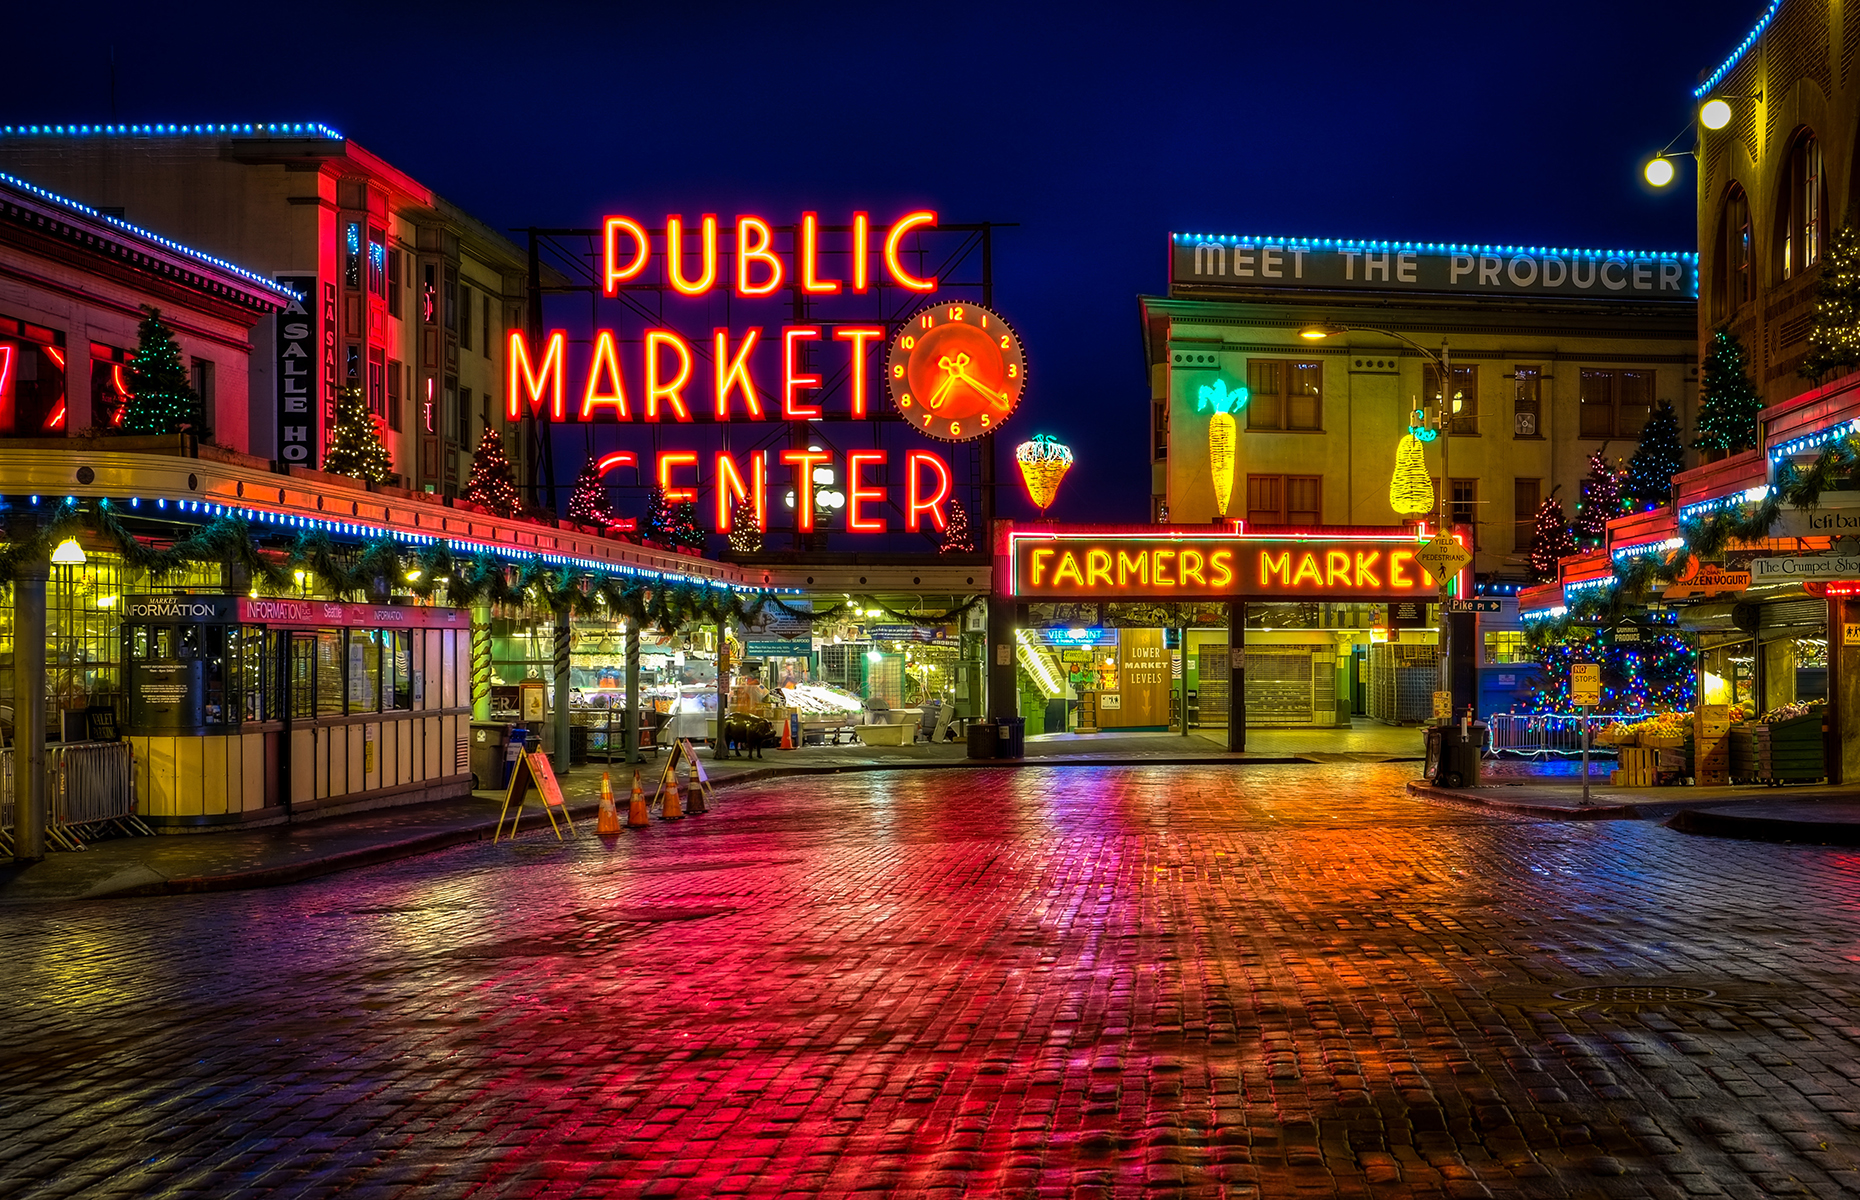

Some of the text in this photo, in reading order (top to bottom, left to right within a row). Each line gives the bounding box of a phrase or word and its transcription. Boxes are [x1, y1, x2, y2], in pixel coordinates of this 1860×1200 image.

[603, 209, 938, 298] PUBLIC
[1194, 242, 1682, 291] MEET THE PRODUCER
[326, 285, 334, 322] LA
[949, 306, 963, 320] 12
[922, 315, 932, 328] 11
[982, 315, 987, 328] 1
[901, 336, 915, 349] 10
[1001, 335, 1010, 348] 2
[282, 323, 309, 413] SALLE
[507, 325, 886, 423] MARKET
[893, 365, 904, 378] 9
[1008, 364, 1017, 377] 3
[326, 331, 334, 419] SALLE
[901, 394, 911, 407] 8
[923, 414, 932, 426] 7
[981, 414, 990, 427] 5
[950, 422, 960, 435] 6
[282, 426, 309, 468] HO
[1837, 514, 1860, 528] ba
[1032, 550, 1431, 586] FARMERS MARKE
[1757, 560, 1779, 574] The
[1782, 559, 1831, 574] Crumpet
[1714, 575, 1748, 585] YOGURT
[247, 601, 302, 620] INFORMATION
[323, 603, 342, 618] Seattle
[1453, 600, 1473, 610] Pike
[374, 610, 404, 621] INFORMATION
[1614, 633, 1640, 642] PRODUCE
[1132, 647, 1160, 658] LOWER
[1574, 665, 1586, 673] NO
[1131, 673, 1162, 684] LEVELS
[91, 712, 114, 725] VALET
